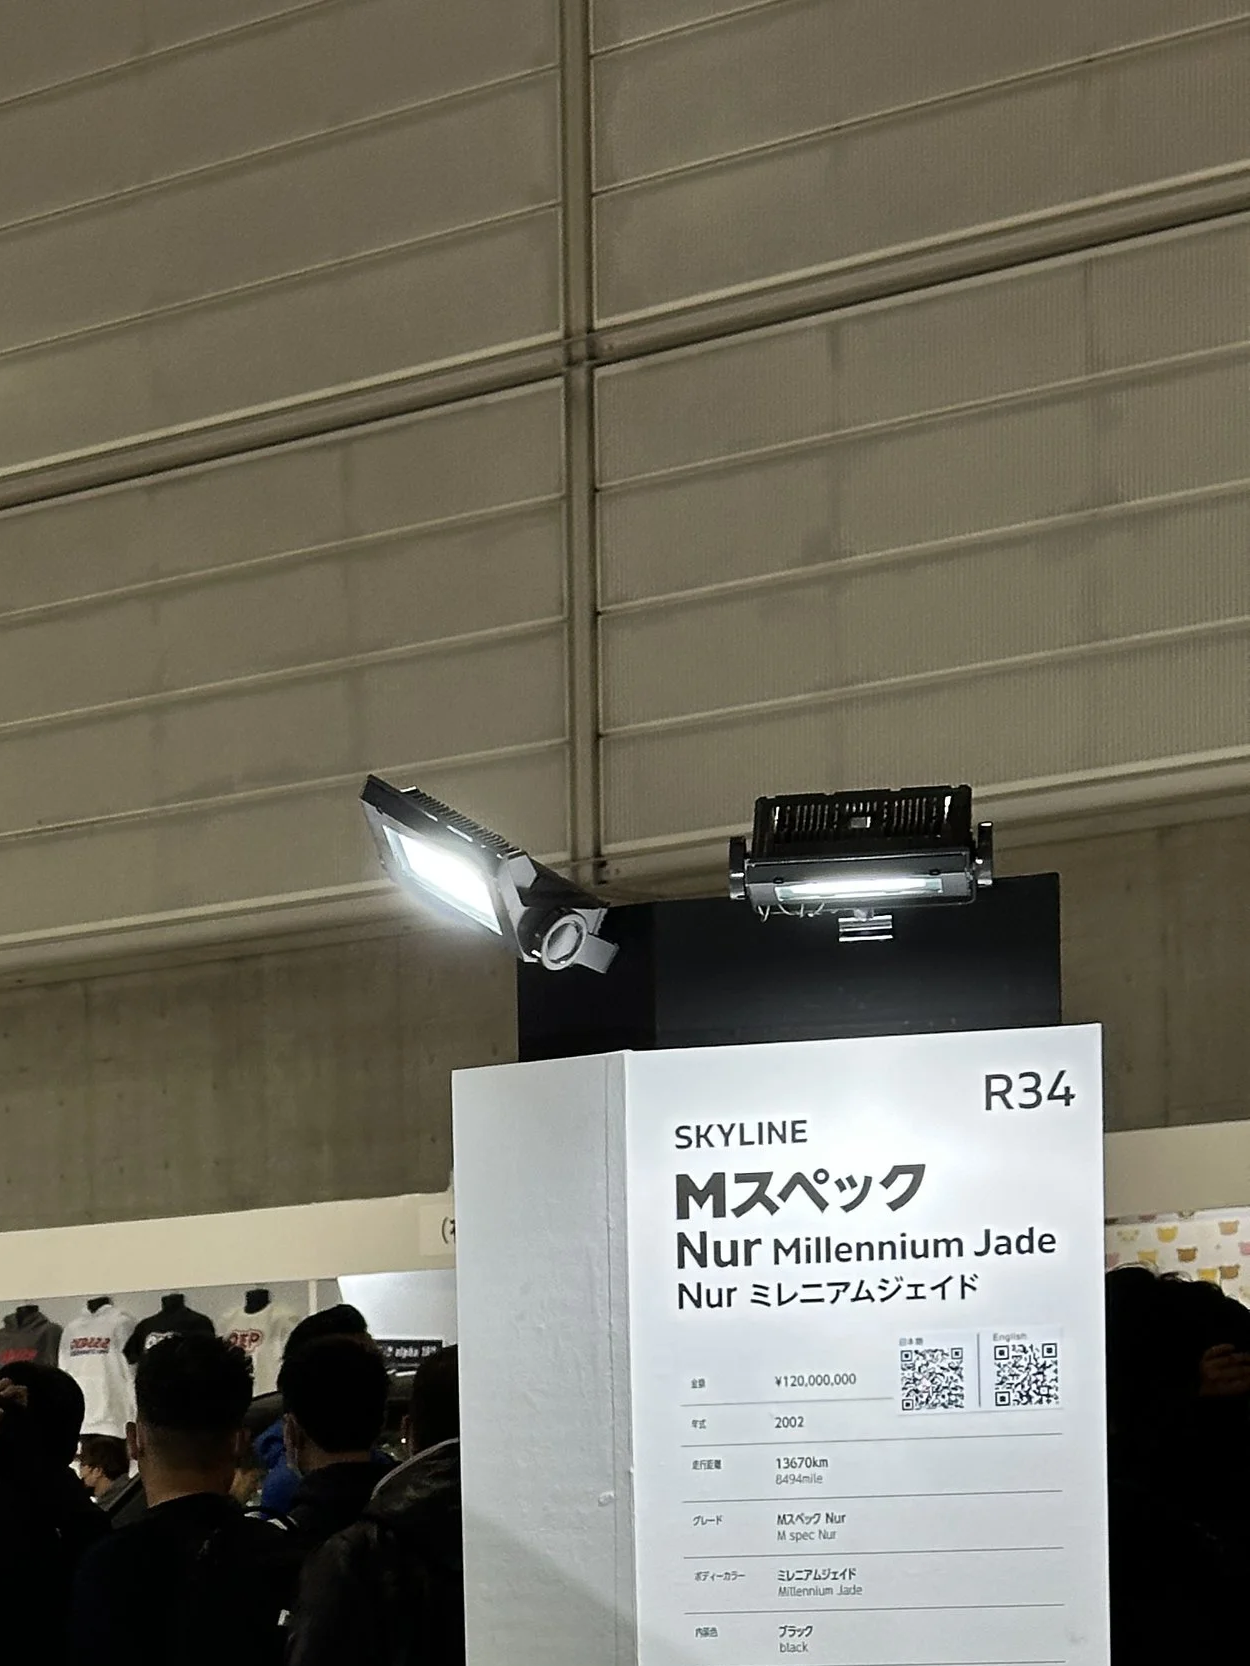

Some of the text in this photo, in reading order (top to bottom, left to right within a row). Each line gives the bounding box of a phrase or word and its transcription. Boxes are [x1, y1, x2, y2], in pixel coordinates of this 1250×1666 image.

[984, 1069, 1076, 1111] R34
[674, 1119, 809, 1150] SKYLINE
[675, 1163, 926, 1221] Mスペック
[676, 1226, 1057, 1269] Nur Millennium Jade
[677, 1273, 979, 1310] Nur ミレニアムジェイド
[992, 1332, 1027, 1344] English
[774, 1373, 857, 1388] ¥120,000,000
[691, 1418, 707, 1429] 年式
[774, 1416, 805, 1429] 2002
[691, 1459, 722, 1470] 走行距離
[775, 1455, 829, 1470] 13670km
[775, 1471, 823, 1485] 8494mile
[692, 1514, 724, 1526] グレード
[776, 1512, 846, 1526] Mスペック Nur
[776, 1529, 836, 1543] M spec Nur
[693, 1570, 746, 1582] ボディーカラー
[777, 1567, 857, 1582] ミレニアムジェイド
[777, 1584, 863, 1597] Millennium Jade
[777, 1625, 814, 1638] ブラック
[779, 1641, 809, 1653] black
